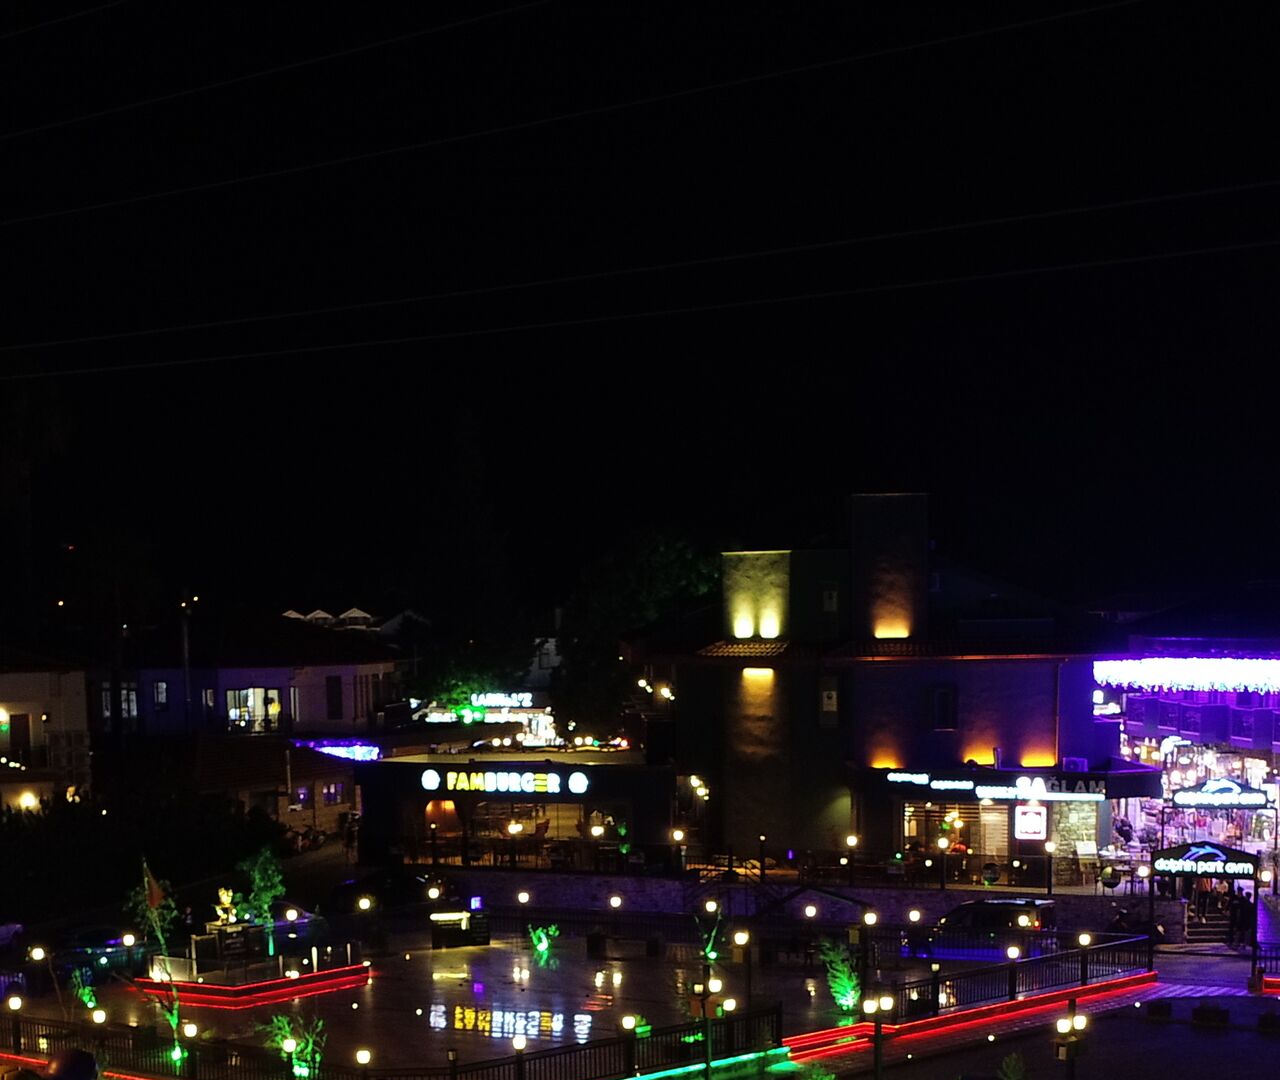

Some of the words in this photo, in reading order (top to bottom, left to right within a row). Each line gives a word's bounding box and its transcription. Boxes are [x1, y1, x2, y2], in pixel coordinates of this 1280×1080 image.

[447, 772, 560, 793] FAMBURGER
[1015, 776, 1106, 793] SAĞLAM
[1154, 857, 1196, 874] dolphin
[1197, 861, 1224, 874] park
